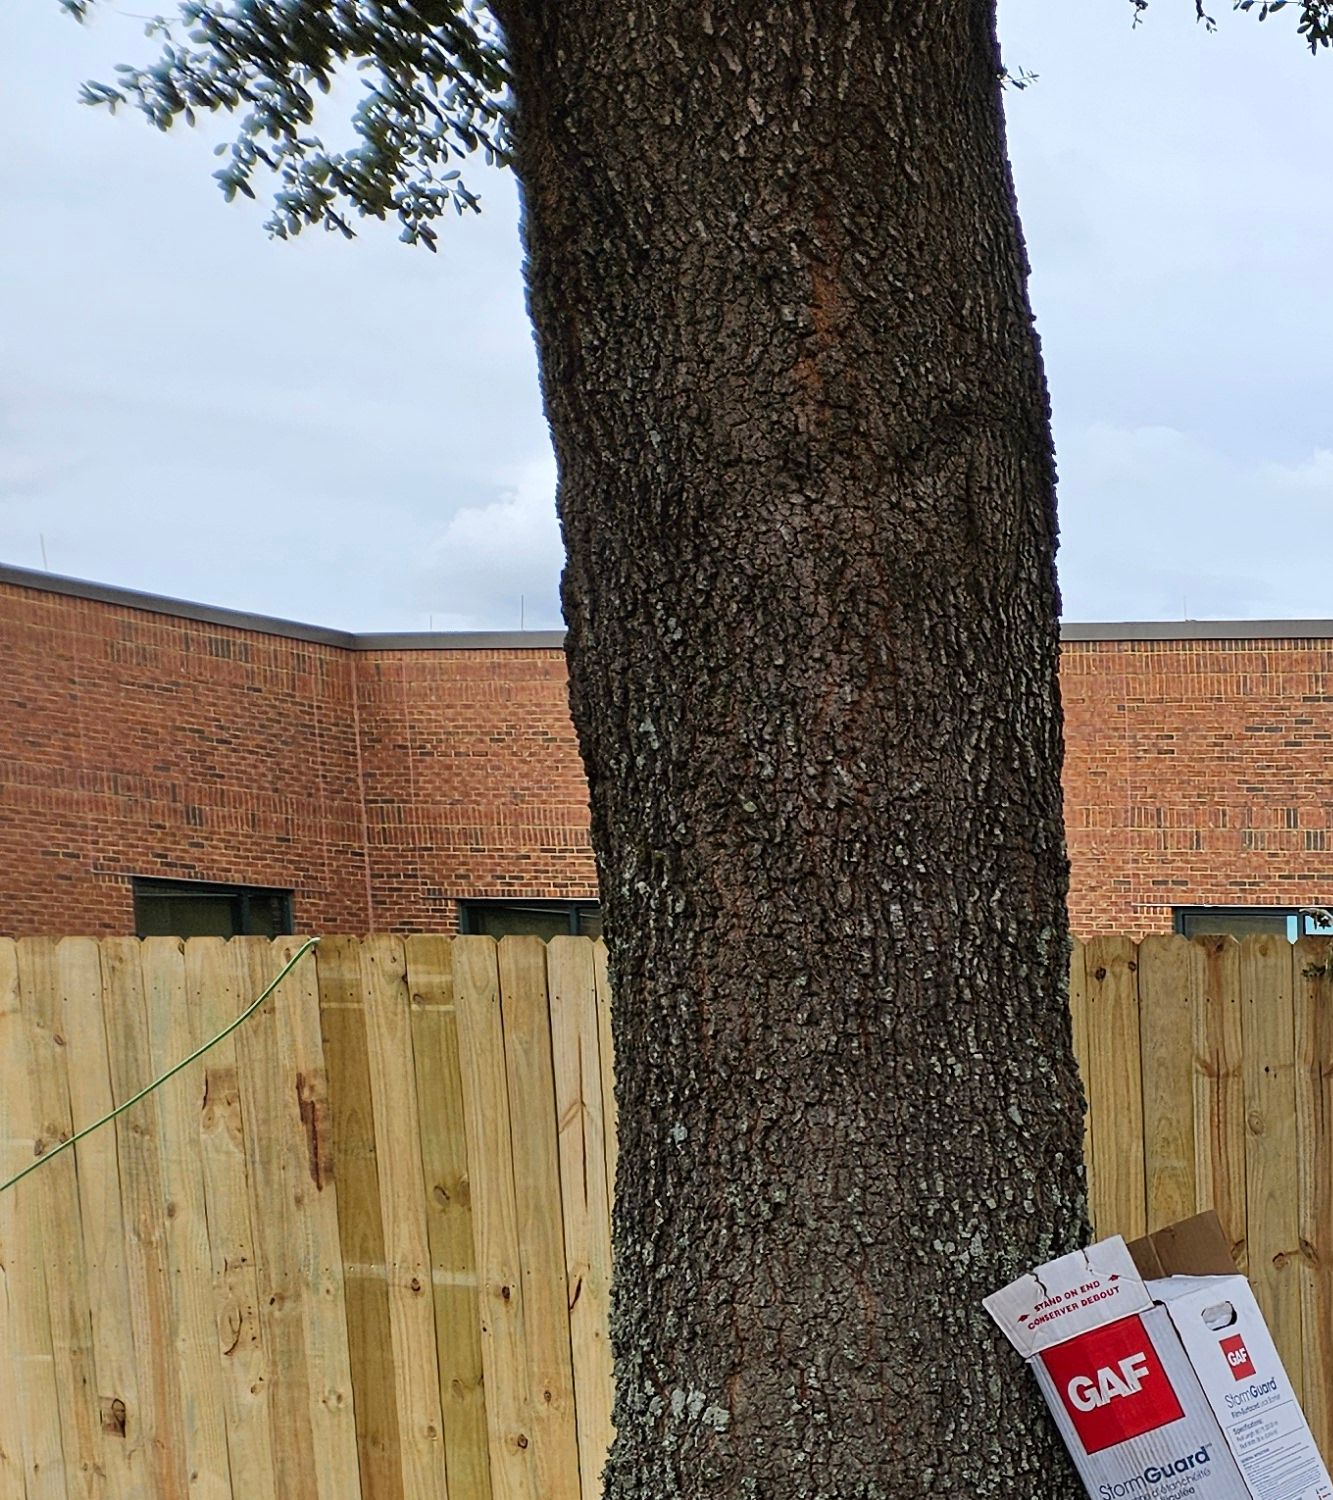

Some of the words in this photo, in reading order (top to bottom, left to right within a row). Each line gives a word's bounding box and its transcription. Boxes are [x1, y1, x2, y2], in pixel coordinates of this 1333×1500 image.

[1027, 1302, 1080, 1330] CONSERVER
[1081, 1285, 1120, 1307] DEBOUT
[1034, 1295, 1063, 1312] STAND
[1064, 1288, 1079, 1300] ON
[1080, 1280, 1101, 1294] END
[1227, 1347, 1248, 1367] GAF
[1067, 1351, 1150, 1412] GAF
[1225, 1376, 1278, 1409] StormGuard
